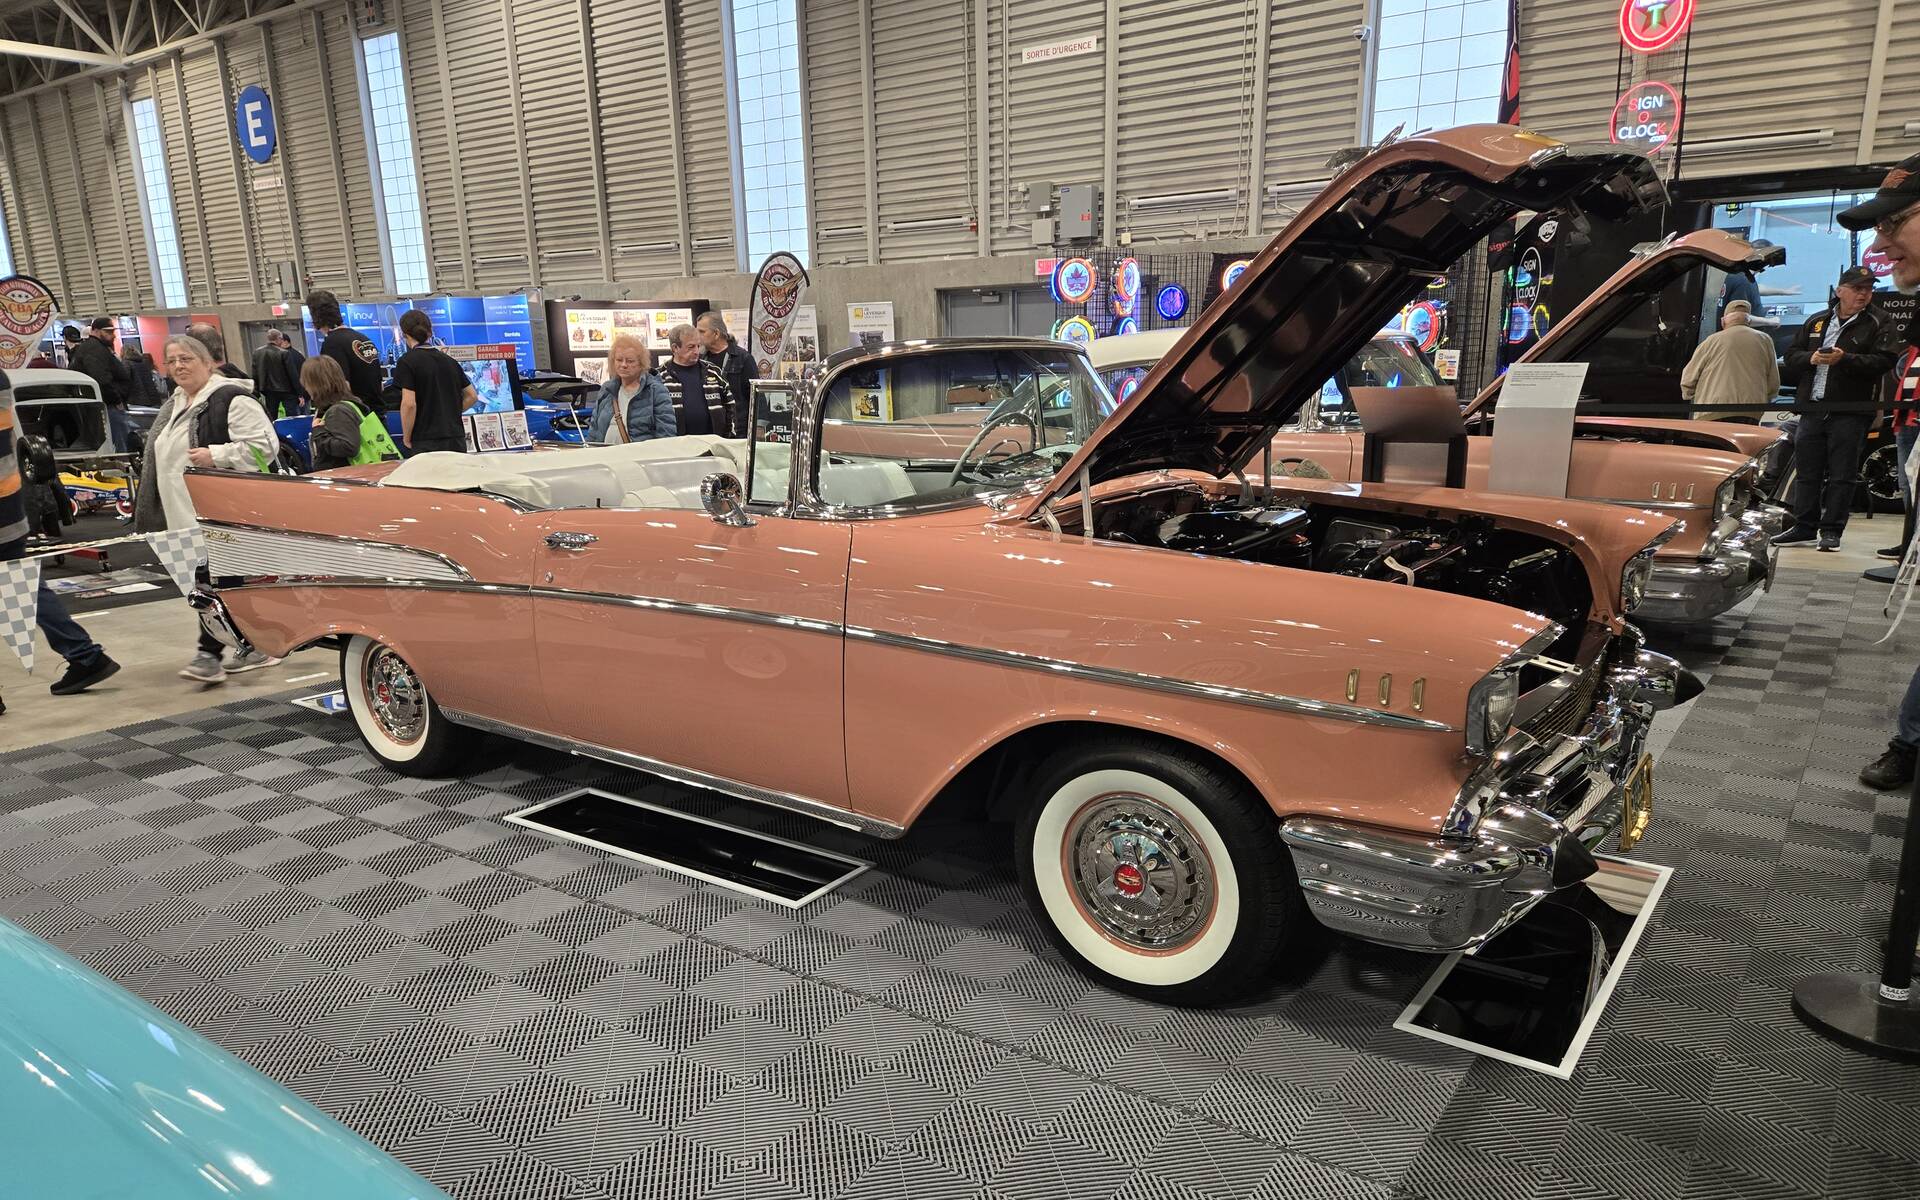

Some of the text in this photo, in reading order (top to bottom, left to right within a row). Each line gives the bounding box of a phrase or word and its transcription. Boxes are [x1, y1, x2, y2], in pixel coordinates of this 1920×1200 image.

[1647, 3, 1665, 28] T
[1026, 40, 1092, 60] SORTIE D'URGENCE
[1628, 94, 1664, 112] SIGN
[244, 100, 268, 147] E
[1638, 111, 1650, 123] O
[1618, 122, 1667, 139] CLOCK
[1649, 134, 1668, 143] .com
[1524, 259, 1537, 271] SIGN
[1519, 285, 1537, 299] CLOCK
[9, 303, 33, 313] CBA
[1883, 299, 1916, 308] NOUS
[477, 345, 500, 353] GARAGE
